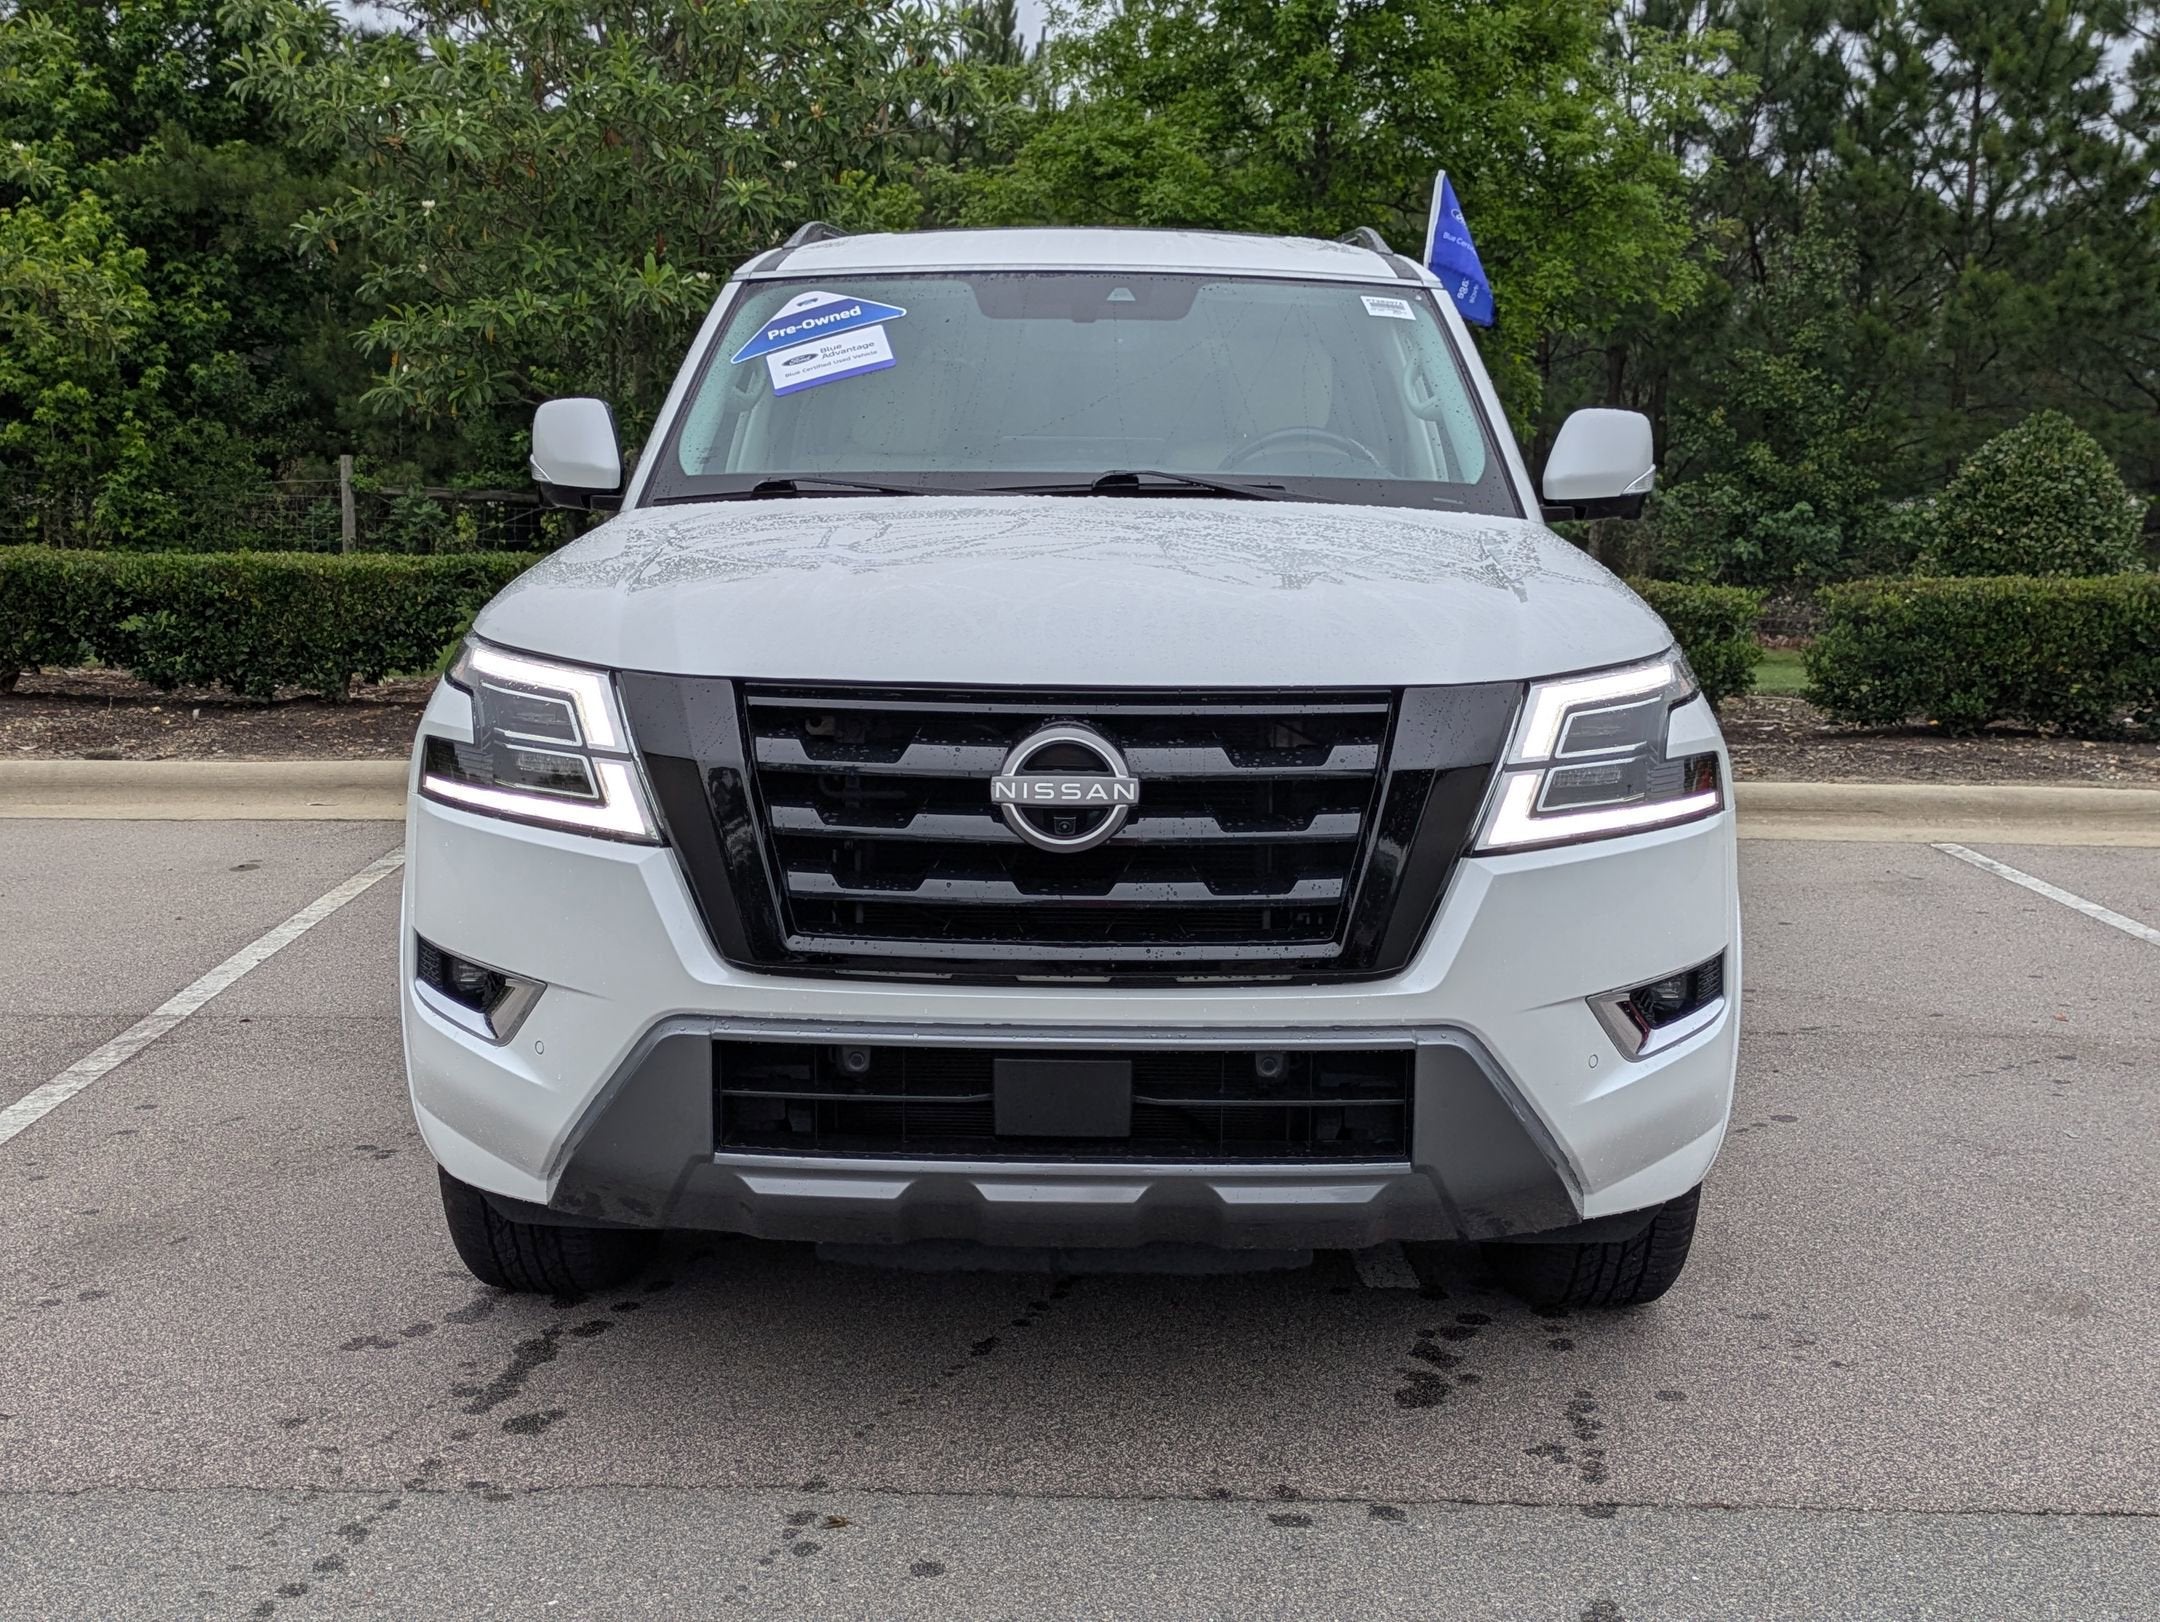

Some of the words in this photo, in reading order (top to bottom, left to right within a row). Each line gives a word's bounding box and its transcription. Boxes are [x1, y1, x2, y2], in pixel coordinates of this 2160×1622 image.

[767, 305, 862, 341] Pre-Owned
[820, 343, 842, 354] Blue
[821, 342, 875, 360] Advantage
[785, 370, 801, 378] Blue
[802, 361, 832, 373] Certified
[833, 356, 851, 365] Used
[995, 782, 1135, 800] NISSAN
